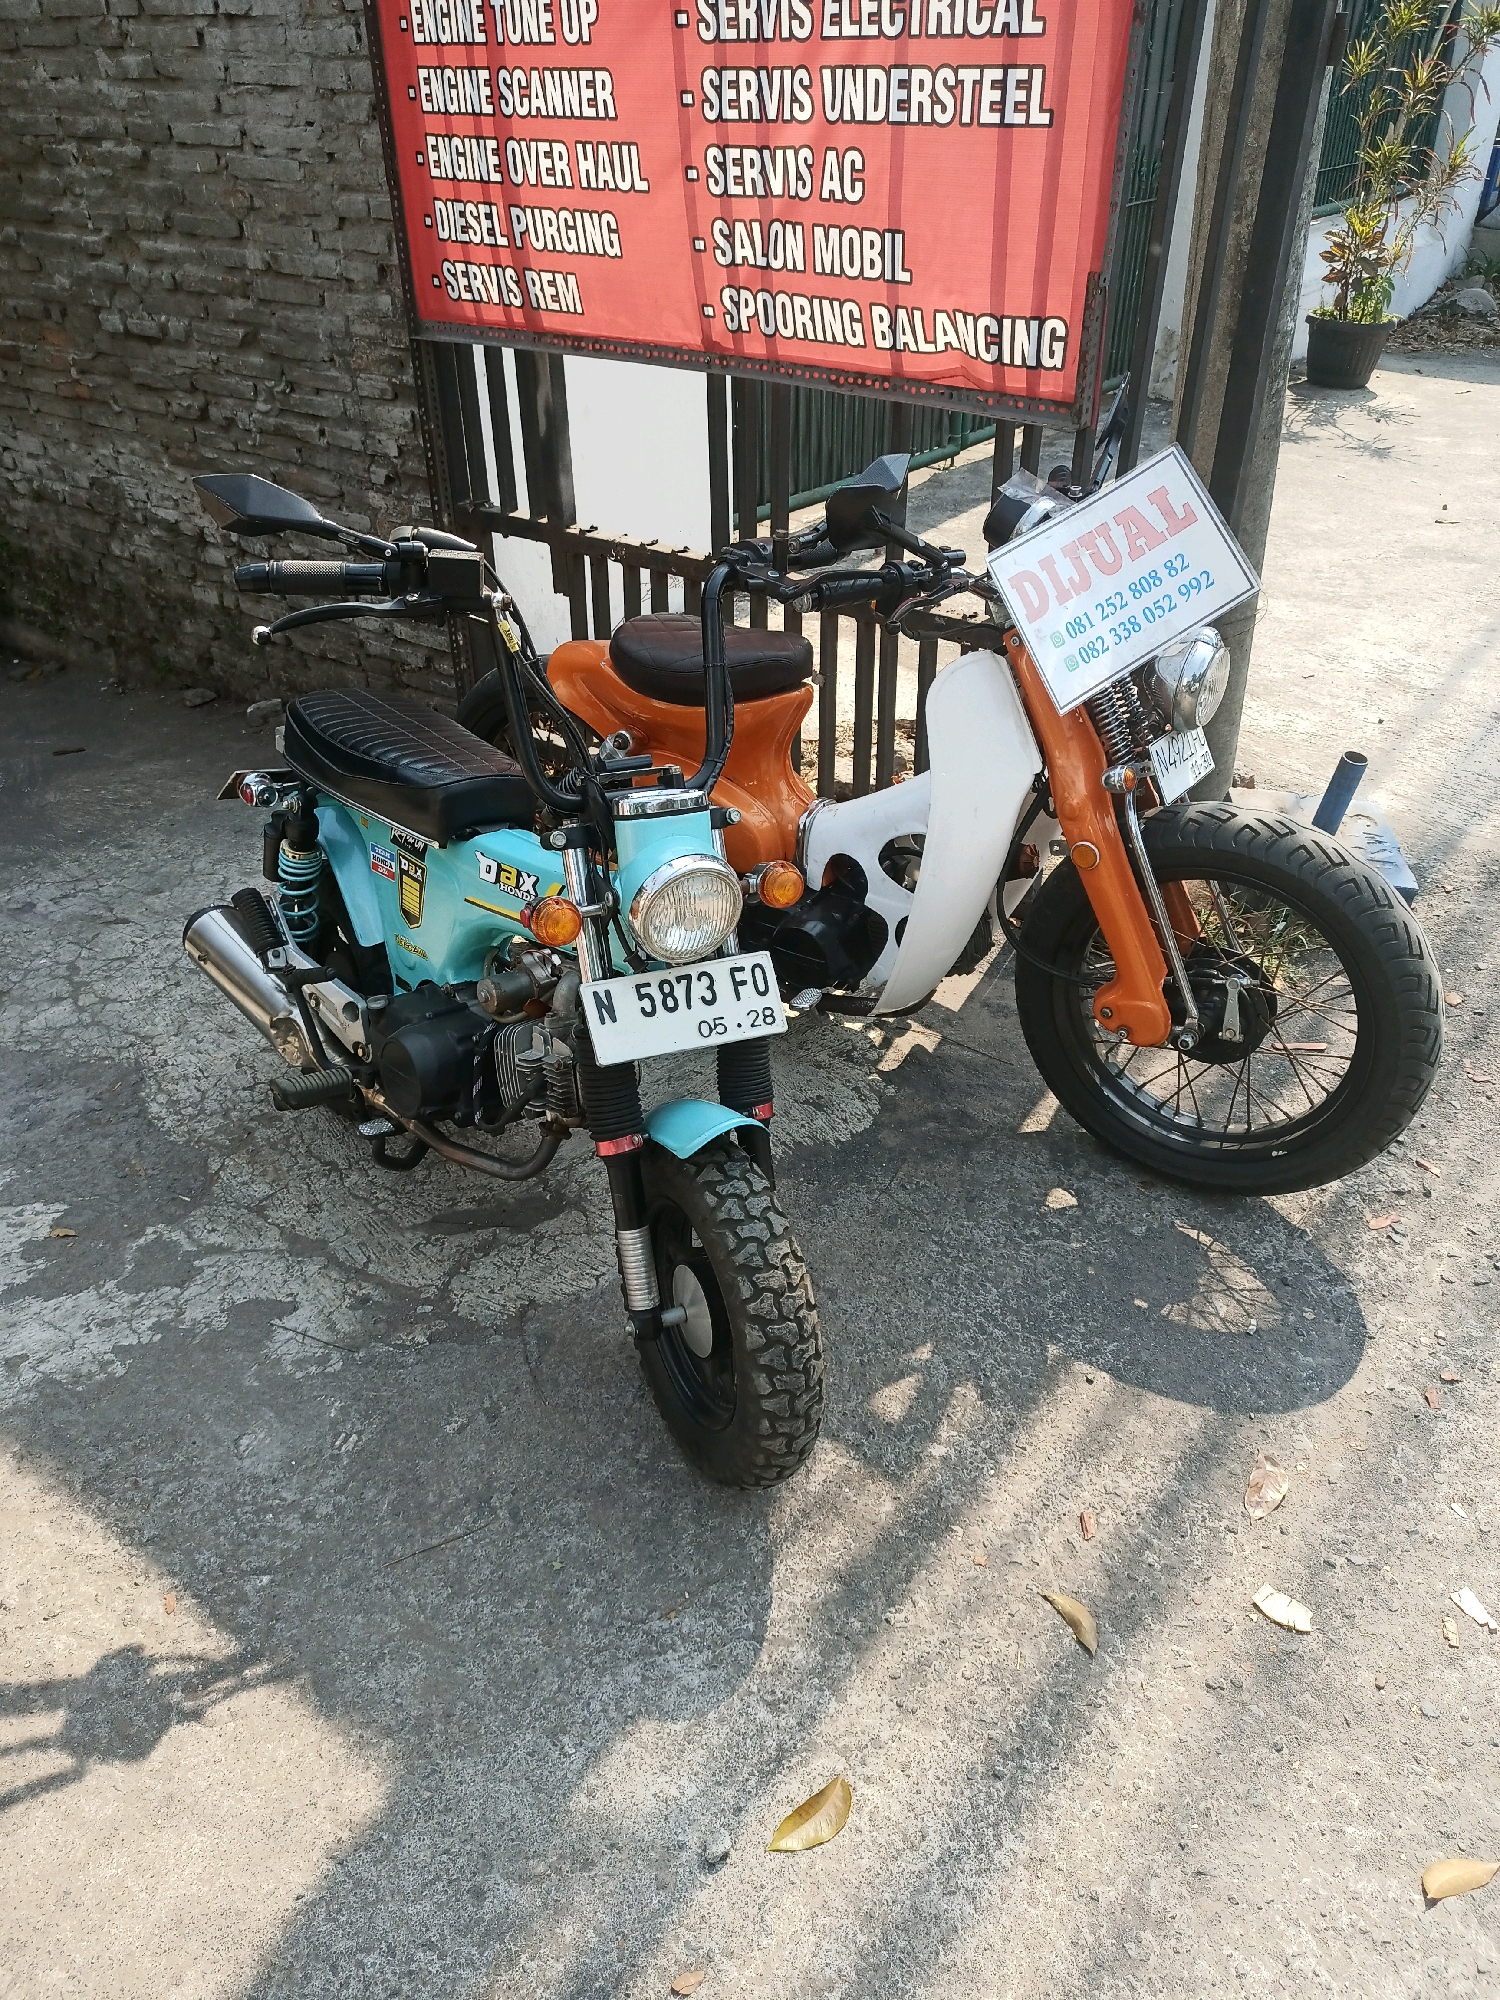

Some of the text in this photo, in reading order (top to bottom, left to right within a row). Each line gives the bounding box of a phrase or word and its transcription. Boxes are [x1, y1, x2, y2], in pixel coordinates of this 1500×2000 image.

[410, 0, 600, 46] ENGINE TUNE UP
[697, 0, 1046, 44] SERVIS ELECTRICAL
[417, 65, 619, 120] ENGINE SCANNER
[701, 63, 1054, 127] SERVIS UNDERSTEEL
[424, 133, 650, 193] ENGINE OVER HAUL
[705, 144, 865, 203] SERVIS AC
[432, 197, 623, 259] DIESEL PURGING
[711, 218, 912, 284] SALON MOBIL
[441, 260, 584, 315] SERVIS REM
[719, 285, 1068, 371] SPOORING BALANCING
[1008, 485, 1199, 625] DIJUAL
[1065, 553, 1190, 640] 081 252 808 82
[1078, 570, 1215, 665] 082 338 052 992
[592, 962, 770, 1026] N 5873 FO
